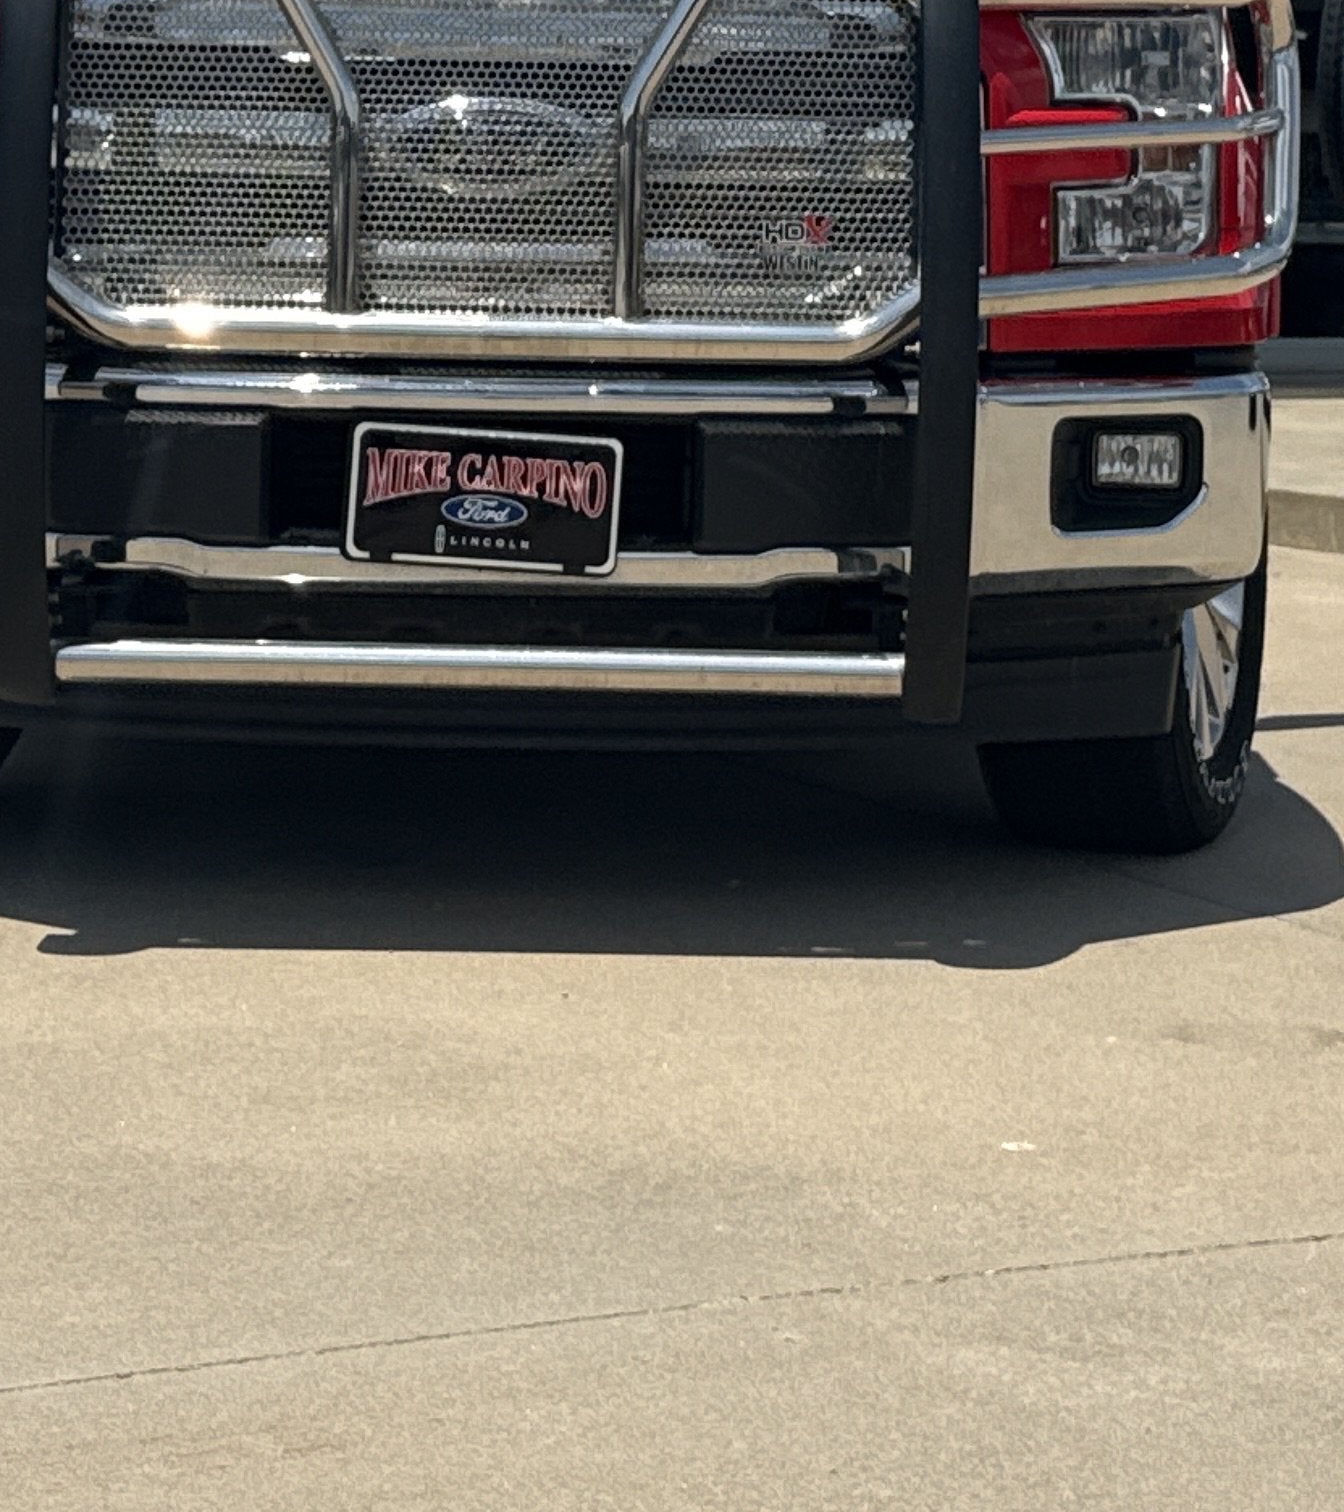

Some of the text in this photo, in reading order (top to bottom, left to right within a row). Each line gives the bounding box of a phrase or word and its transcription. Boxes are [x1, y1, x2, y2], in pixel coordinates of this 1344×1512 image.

[362, 447, 608, 519] MIKE CARPINO
[457, 497, 511, 523] Ford
[449, 535, 531, 550] LINCOLN
